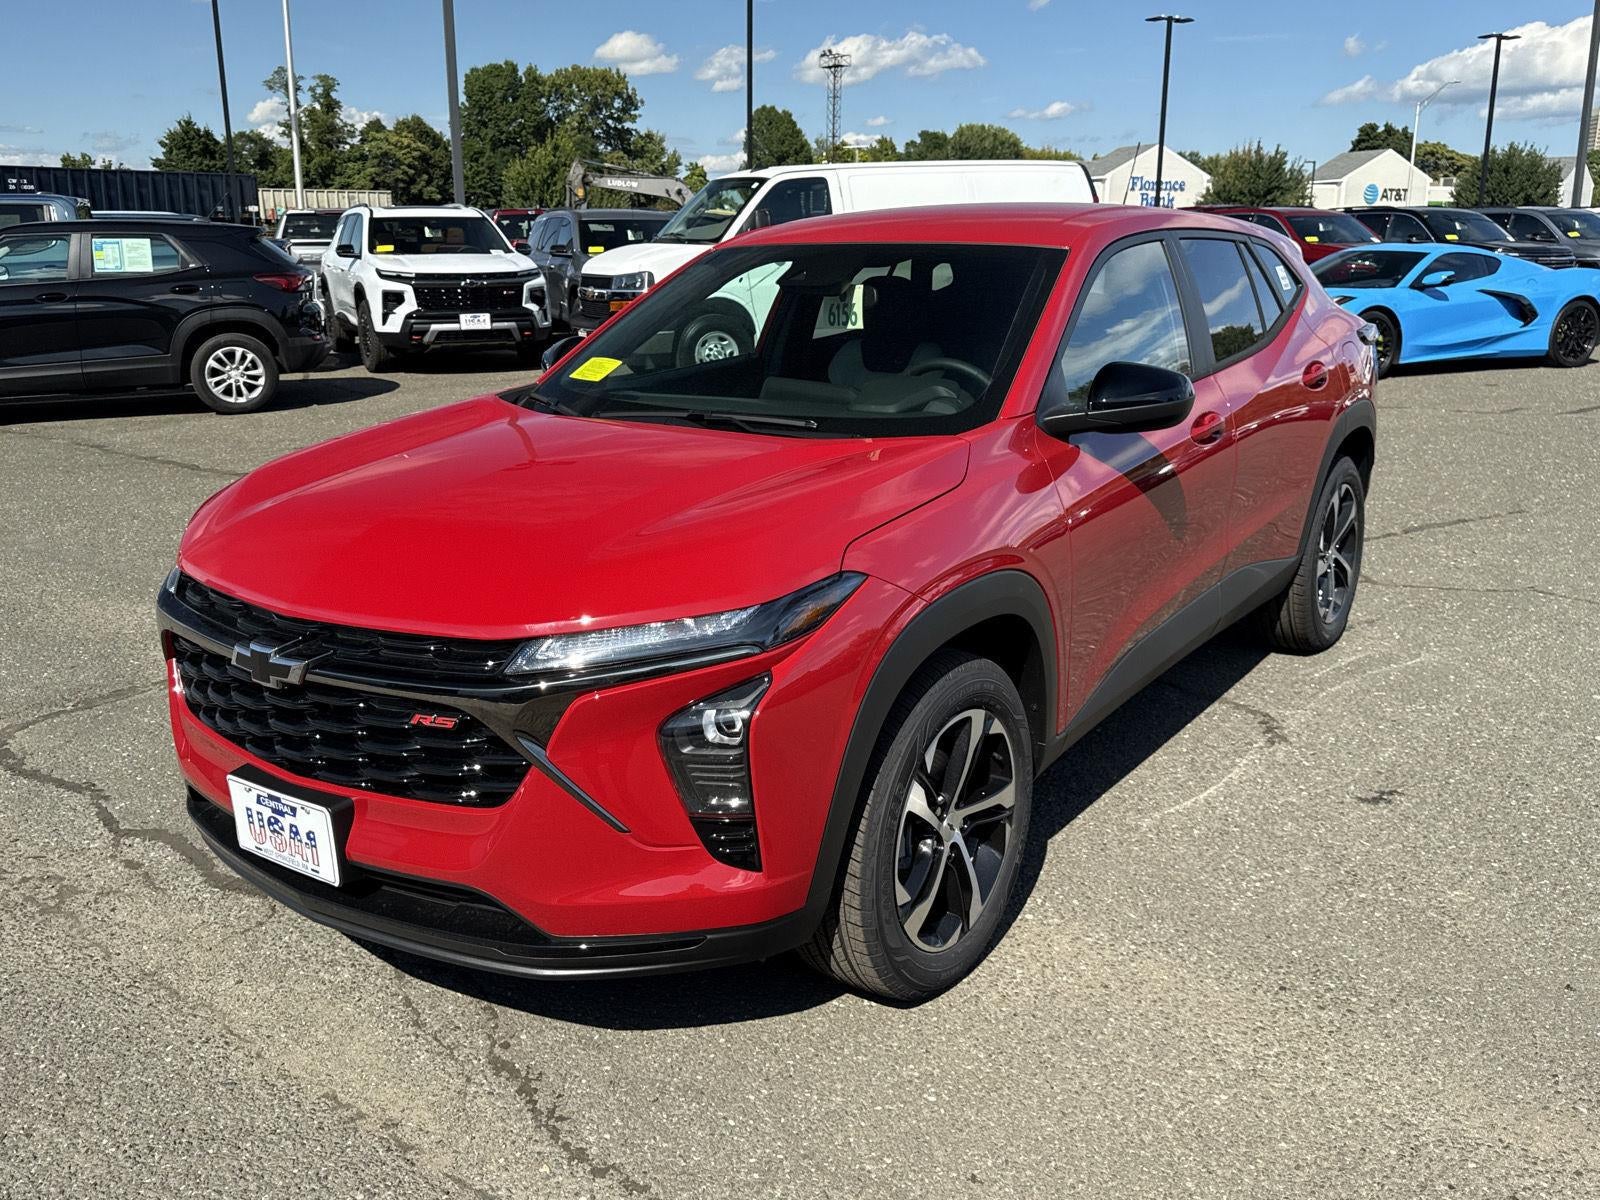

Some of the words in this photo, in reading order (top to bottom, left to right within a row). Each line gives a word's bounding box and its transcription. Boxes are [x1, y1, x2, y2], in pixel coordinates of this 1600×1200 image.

[607, 179, 638, 188] LUDLOW
[1130, 175, 1186, 192] Flornce
[1380, 188, 1408, 202] AT&T
[828, 302, 858, 327] 6156
[410, 713, 458, 729] RS
[260, 796, 294, 815] CENTRAL
